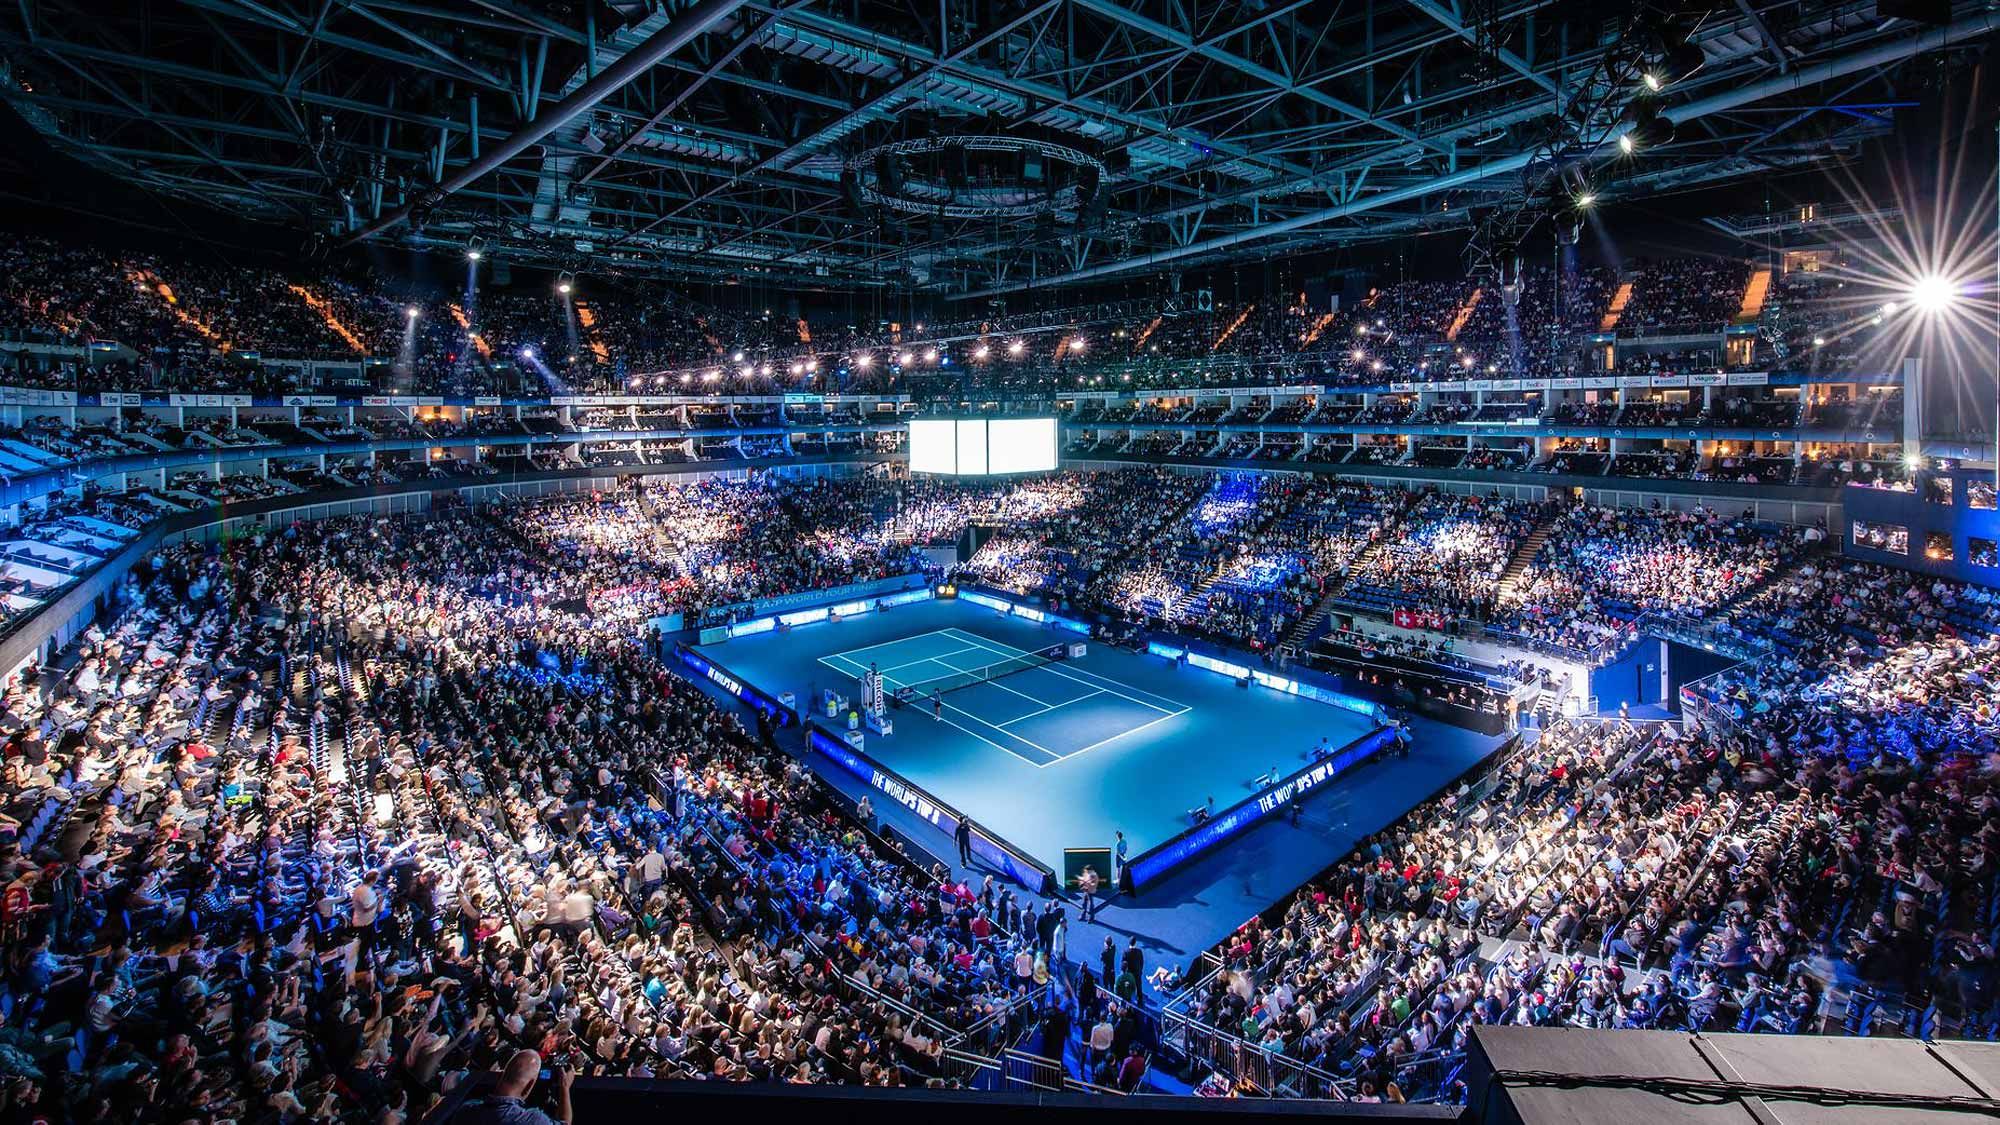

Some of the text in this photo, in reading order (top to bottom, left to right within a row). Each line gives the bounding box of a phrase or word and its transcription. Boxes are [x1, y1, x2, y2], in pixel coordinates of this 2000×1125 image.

[785, 592, 823, 605] WORLD
[826, 587, 851, 598] TOUR
[871, 770, 886, 790] THE
[884, 778, 918, 810] WORLD'S
[916, 798, 933, 819] TOP
[1258, 762, 1334, 813] THE WORD'S TOP 8
